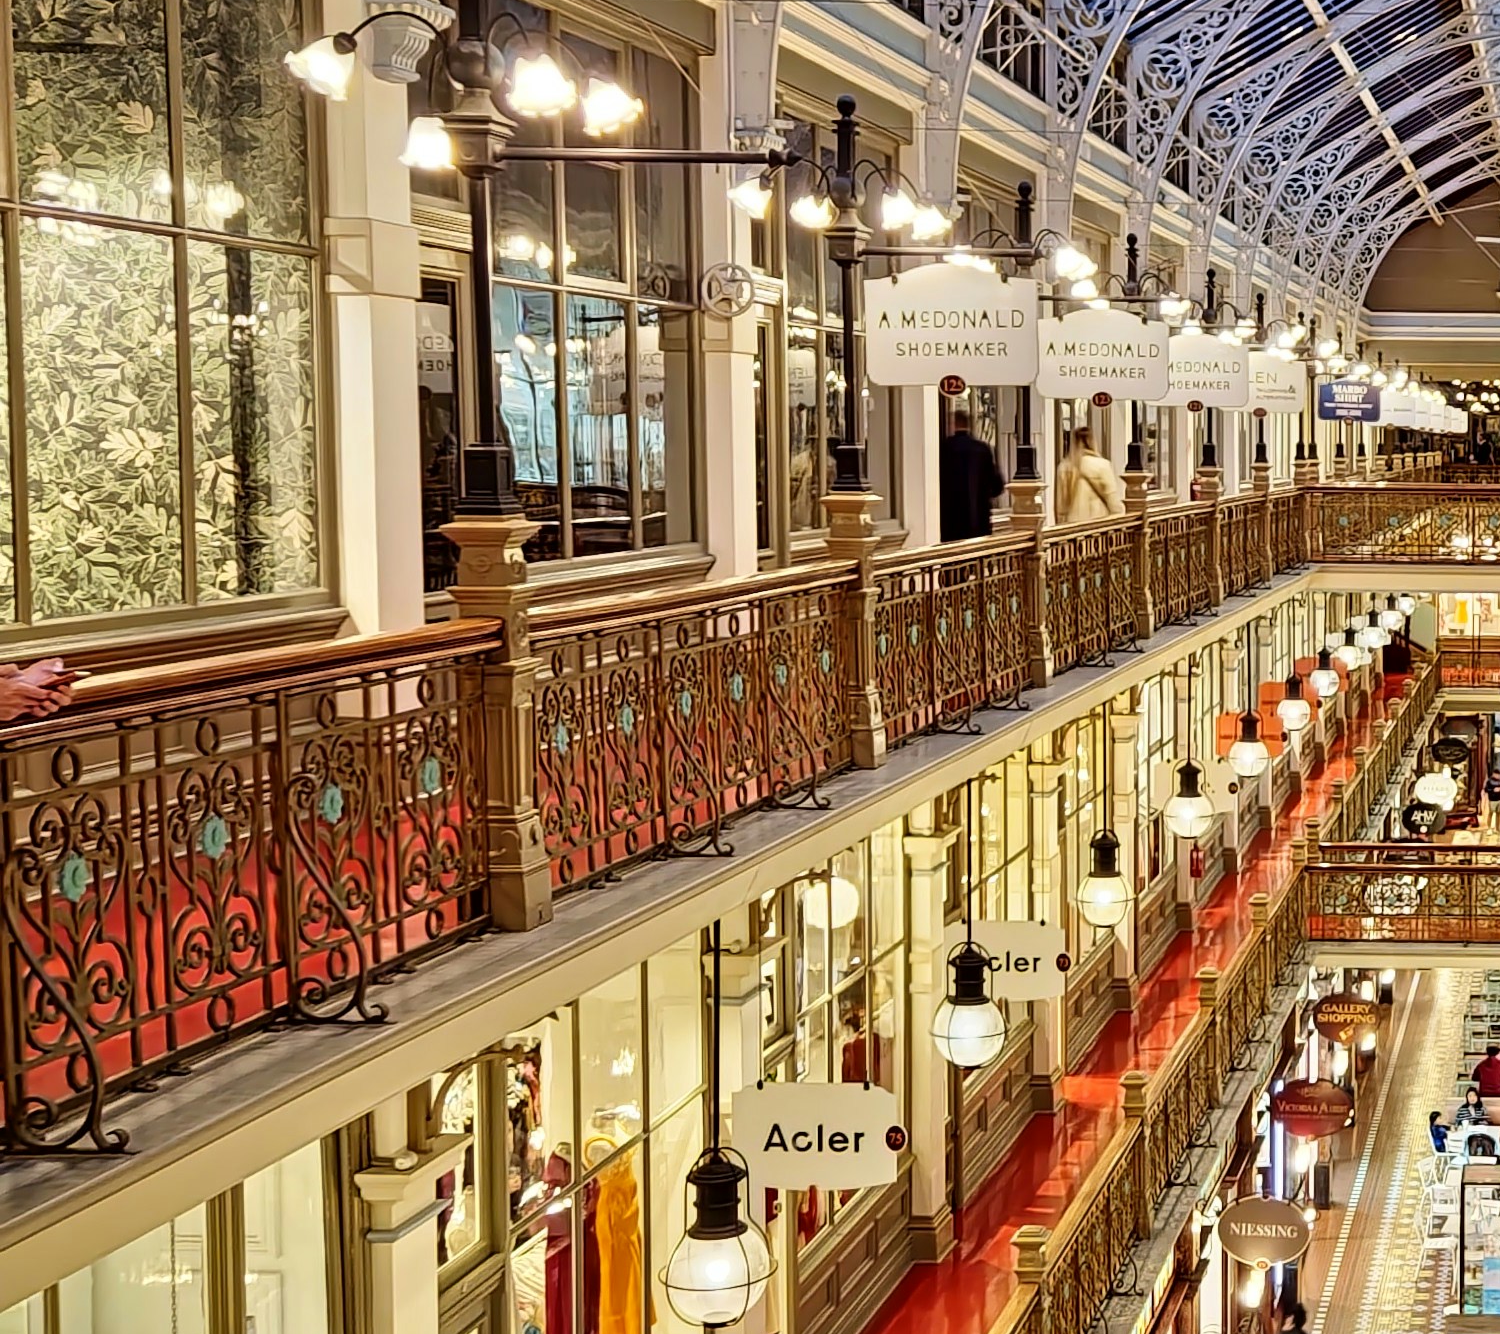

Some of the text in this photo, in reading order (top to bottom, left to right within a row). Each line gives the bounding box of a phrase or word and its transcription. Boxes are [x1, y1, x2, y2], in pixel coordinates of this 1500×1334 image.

[896, 342, 1008, 357] SHOEMAKER
[1059, 366, 1146, 379] SHOEMAKER
[943, 379, 964, 392] 125
[1168, 380, 1230, 391] HOEMAKER
[988, 950, 1041, 973] cler
[1321, 1003, 1371, 1014] GALLERY
[1317, 1013, 1376, 1024] SHOPPING
[763, 1123, 865, 1153] Acler
[888, 1132, 904, 1145] 75
[1229, 1222, 1298, 1238] NIESSING
